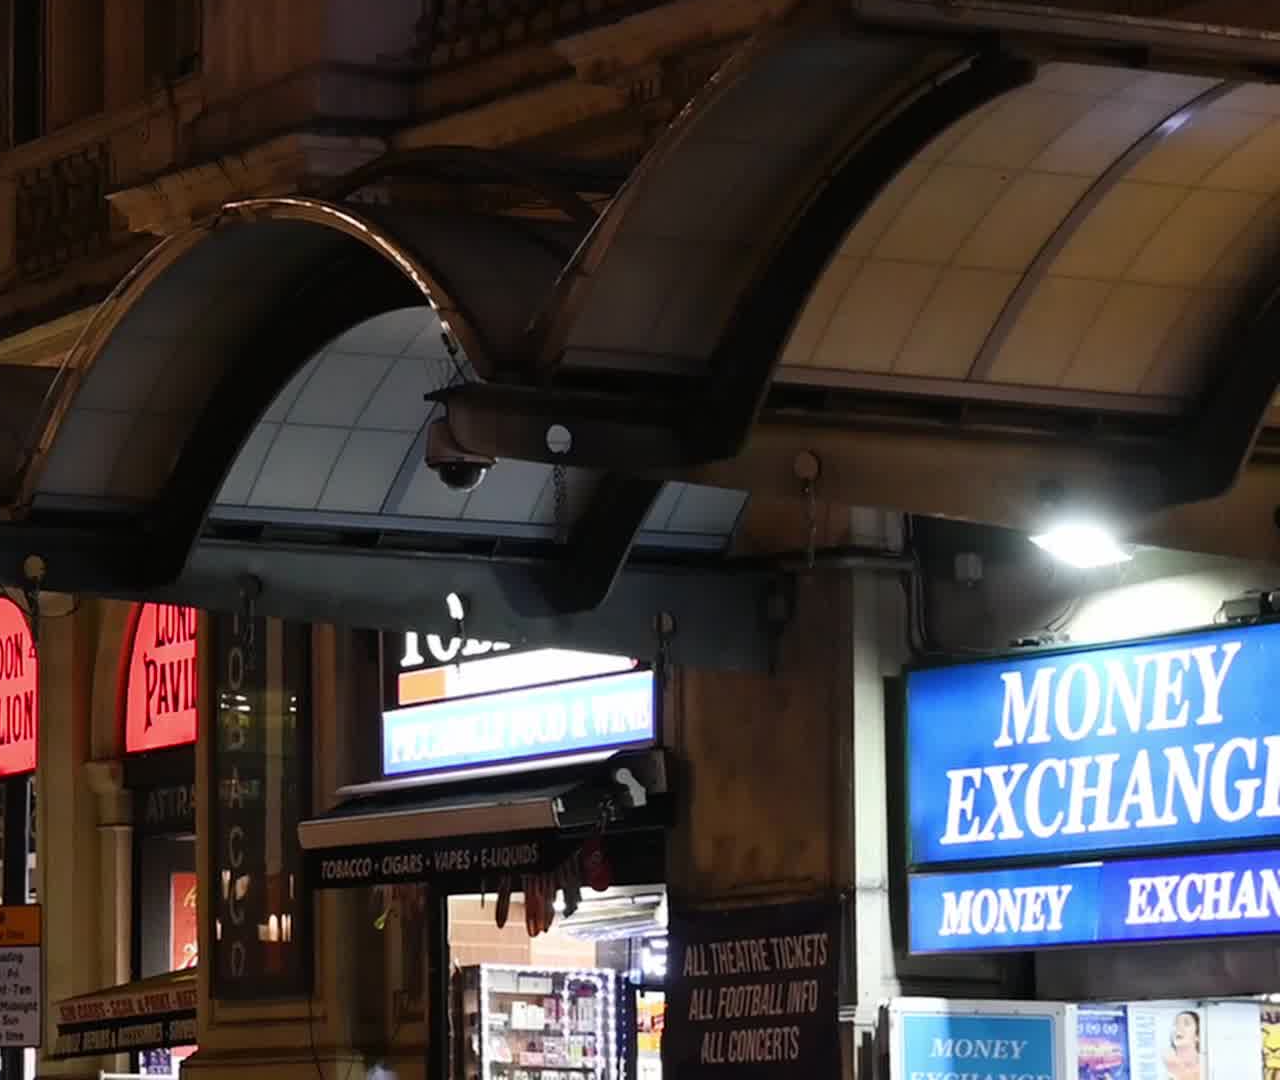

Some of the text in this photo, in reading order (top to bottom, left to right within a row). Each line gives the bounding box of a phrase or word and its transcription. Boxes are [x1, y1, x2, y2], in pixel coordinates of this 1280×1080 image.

[994, 641, 1242, 748] MONEY
[320, 843, 538, 881] TOBACCO CIGARS VAPES E-LIQUIDS
[939, 869, 1280, 936] MONEY EXCHAN
[683, 933, 829, 976] ALL THEATRE TICKETS
[688, 979, 818, 1022] ALL FOOTBALL INFO
[701, 1025, 801, 1064] ALL CONCERTS
[928, 1037, 1028, 1060] MONEY
